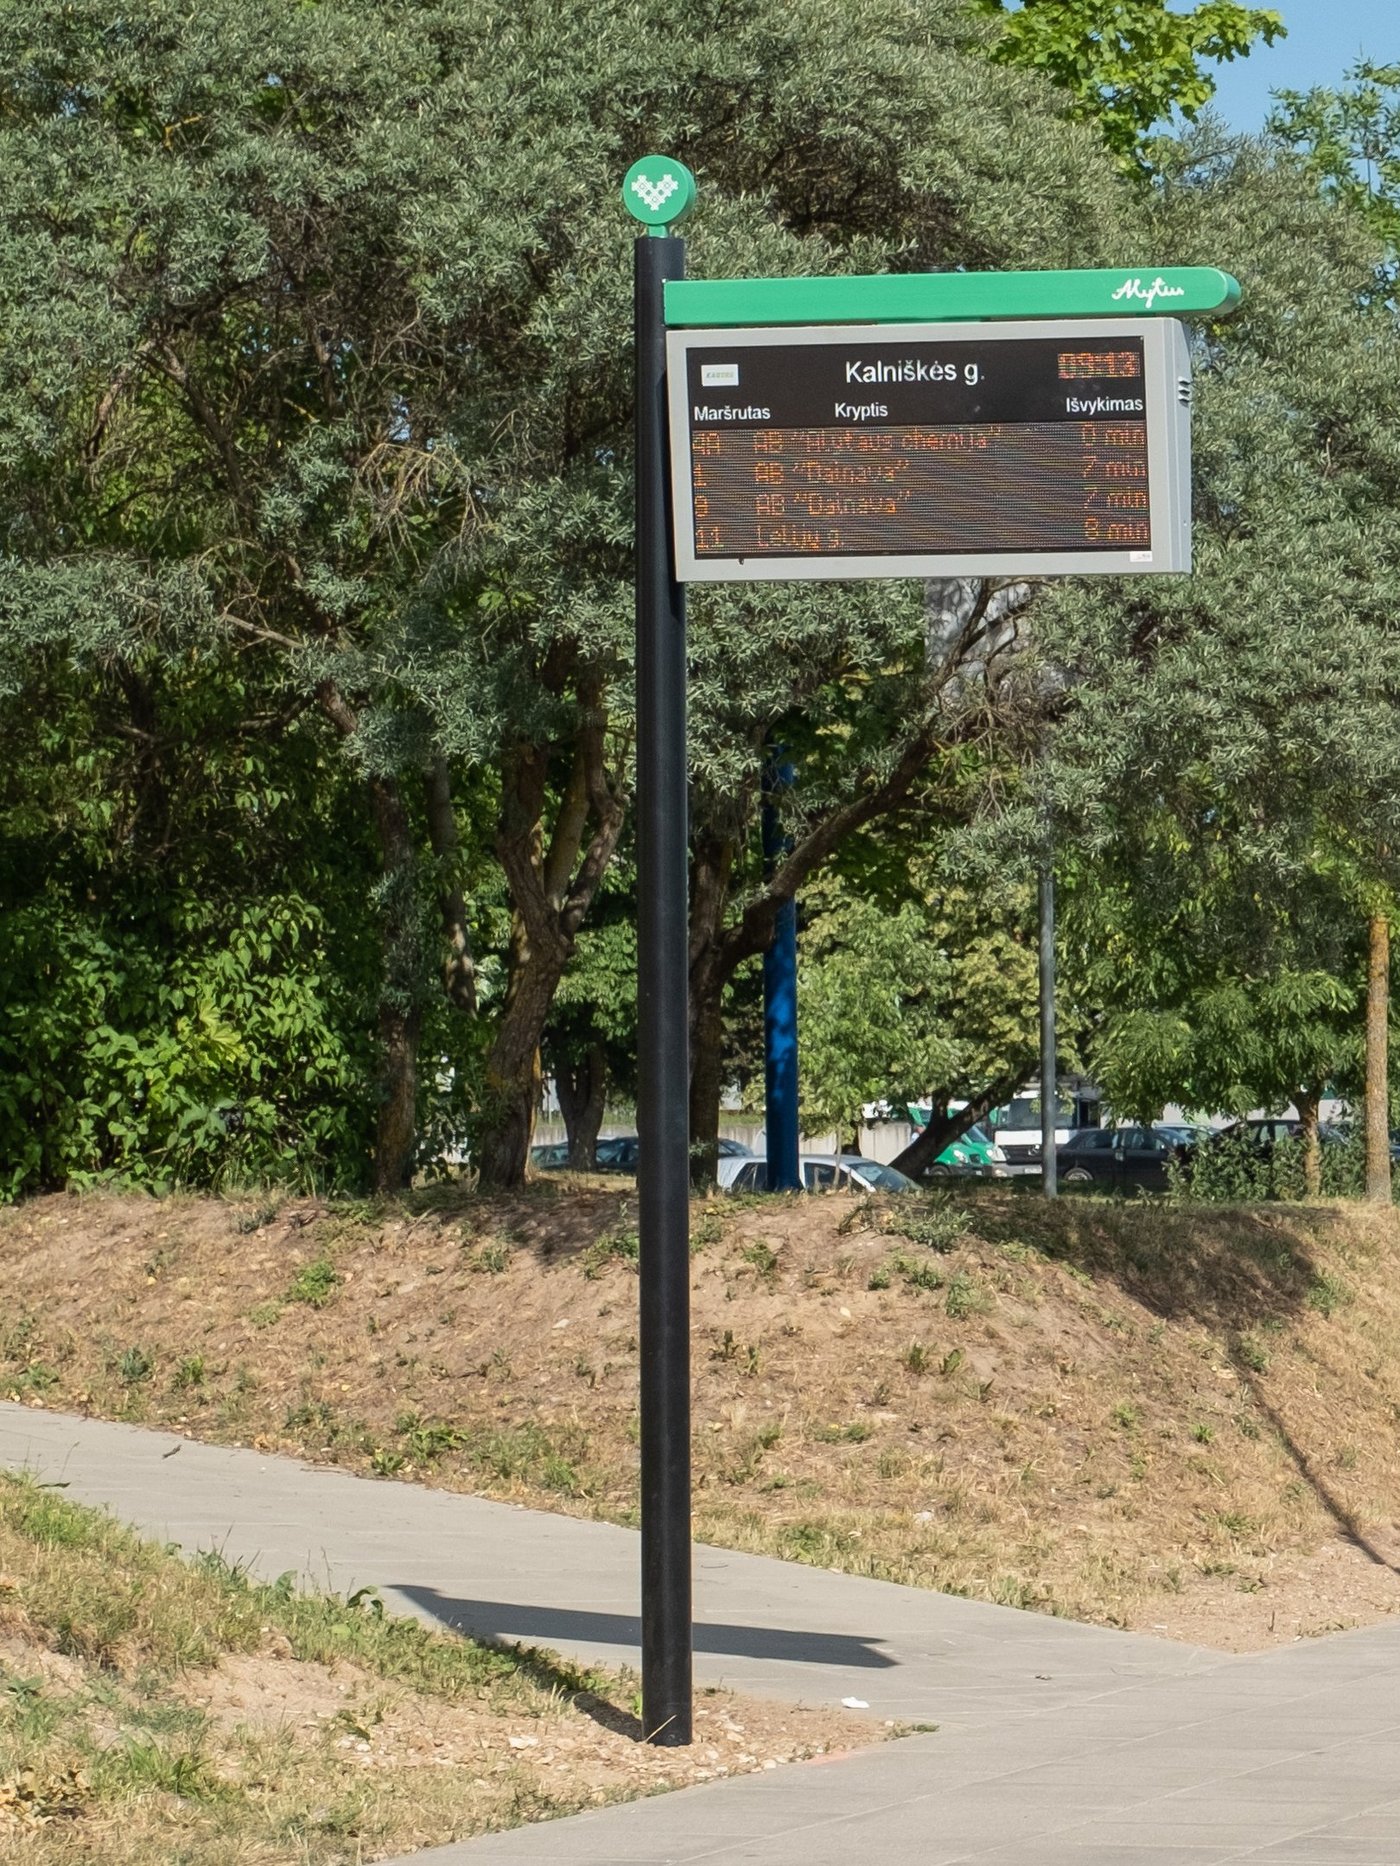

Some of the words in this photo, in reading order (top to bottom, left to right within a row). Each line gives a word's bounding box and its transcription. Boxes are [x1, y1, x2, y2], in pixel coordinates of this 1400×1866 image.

[1111, 276, 1185, 309] Alytus
[846, 359, 957, 384] Kalniškės
[964, 362, 985, 386] g.
[694, 405, 771, 421] Maršrutas
[834, 402, 889, 421] Kryptis
[1066, 396, 1144, 415] Išvykimas
[754, 431, 784, 454] AB
[1105, 424, 1146, 446] min
[693, 463, 707, 487] 1
[755, 461, 785, 485] AB
[1083, 456, 1097, 478] 7
[1105, 456, 1147, 478] min
[756, 493, 785, 516] AB
[1083, 487, 1097, 509] 7
[1107, 487, 1147, 509] min
[695, 526, 724, 549] 11
[1107, 517, 1149, 541] min
